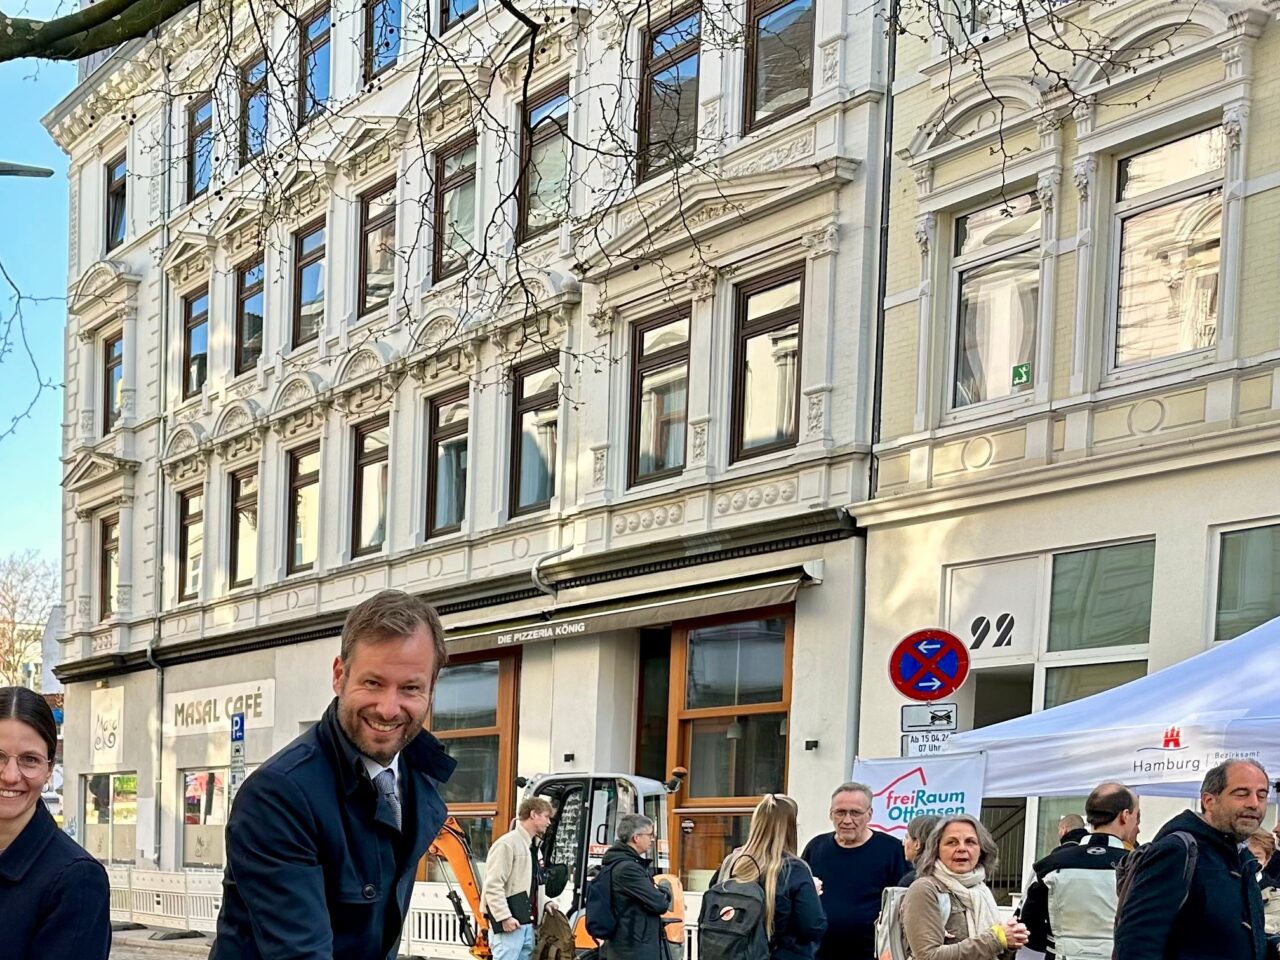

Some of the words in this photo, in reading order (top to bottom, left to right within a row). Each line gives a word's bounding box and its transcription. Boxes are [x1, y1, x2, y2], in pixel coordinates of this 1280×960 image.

[497, 634, 512, 645] DIE
[513, 627, 553, 642] PIZZERIA
[555, 622, 586, 635] KÖNIG
[969, 613, 1015, 650] 92
[174, 698, 220, 728] MASAL
[225, 686, 263, 719] CAFÉ
[232, 716, 241, 739] P
[910, 735, 920, 743] Ab
[918, 744, 927, 752] 07
[928, 743, 941, 752] Uhr
[1133, 758, 1200, 773] Hamburg
[1214, 751, 1261, 759] Bezirksamt
[886, 789, 965, 809] freiRaum
[888, 805, 965, 823] Ottensen
